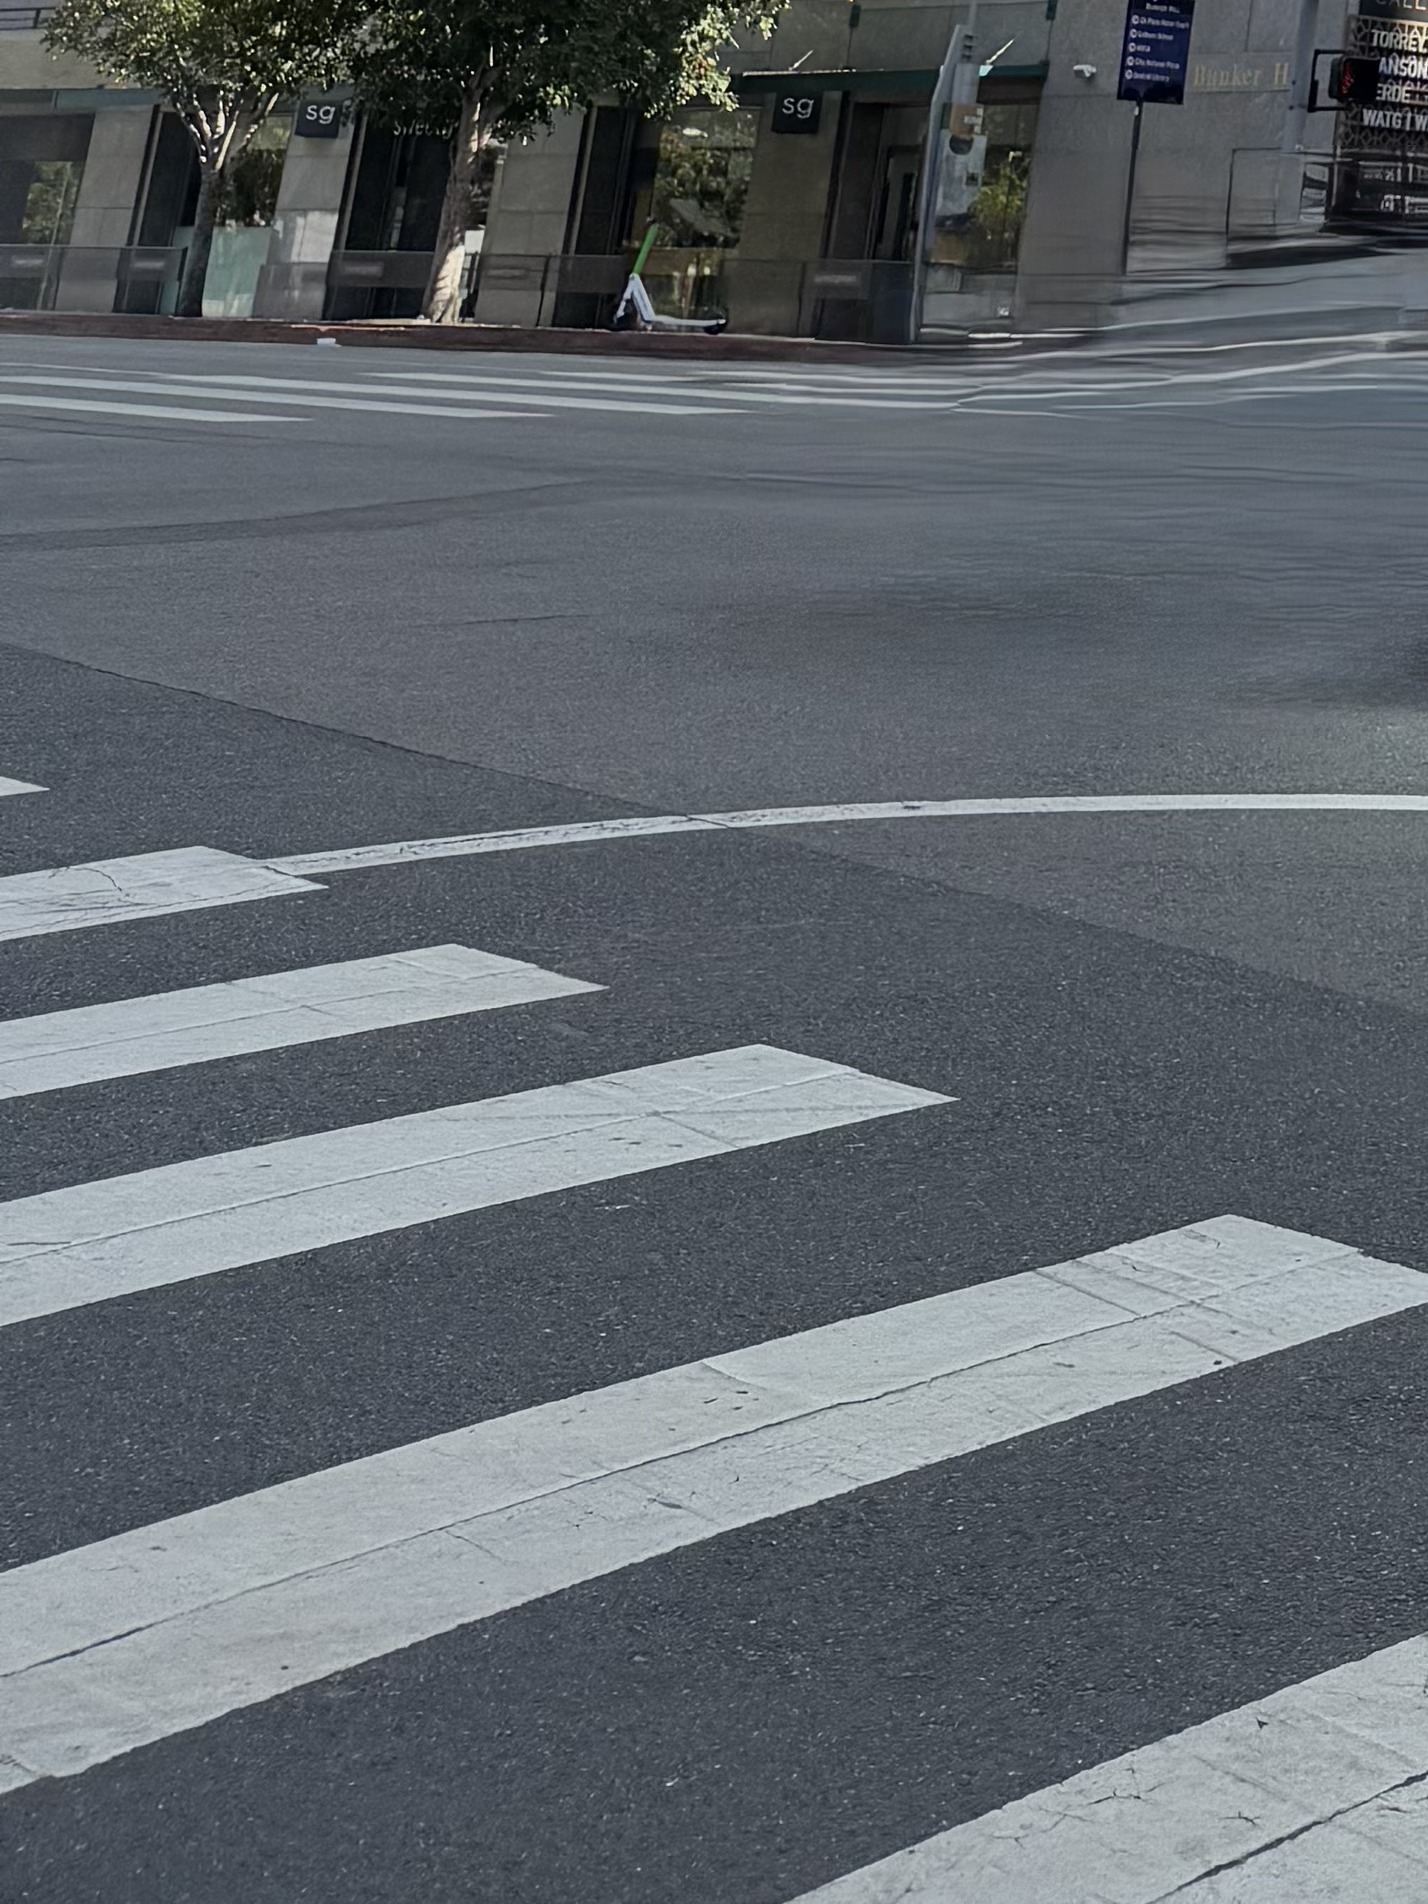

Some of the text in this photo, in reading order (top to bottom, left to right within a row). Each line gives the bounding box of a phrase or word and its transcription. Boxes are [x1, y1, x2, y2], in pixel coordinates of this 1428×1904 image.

[1371, 29, 1427, 54] TORREY
[1194, 63, 1262, 87] Bunker
[1376, 83, 1411, 103] ERDE
[305, 104, 336, 124] sg
[782, 97, 815, 119] sg
[1362, 108, 1402, 130] WATG
